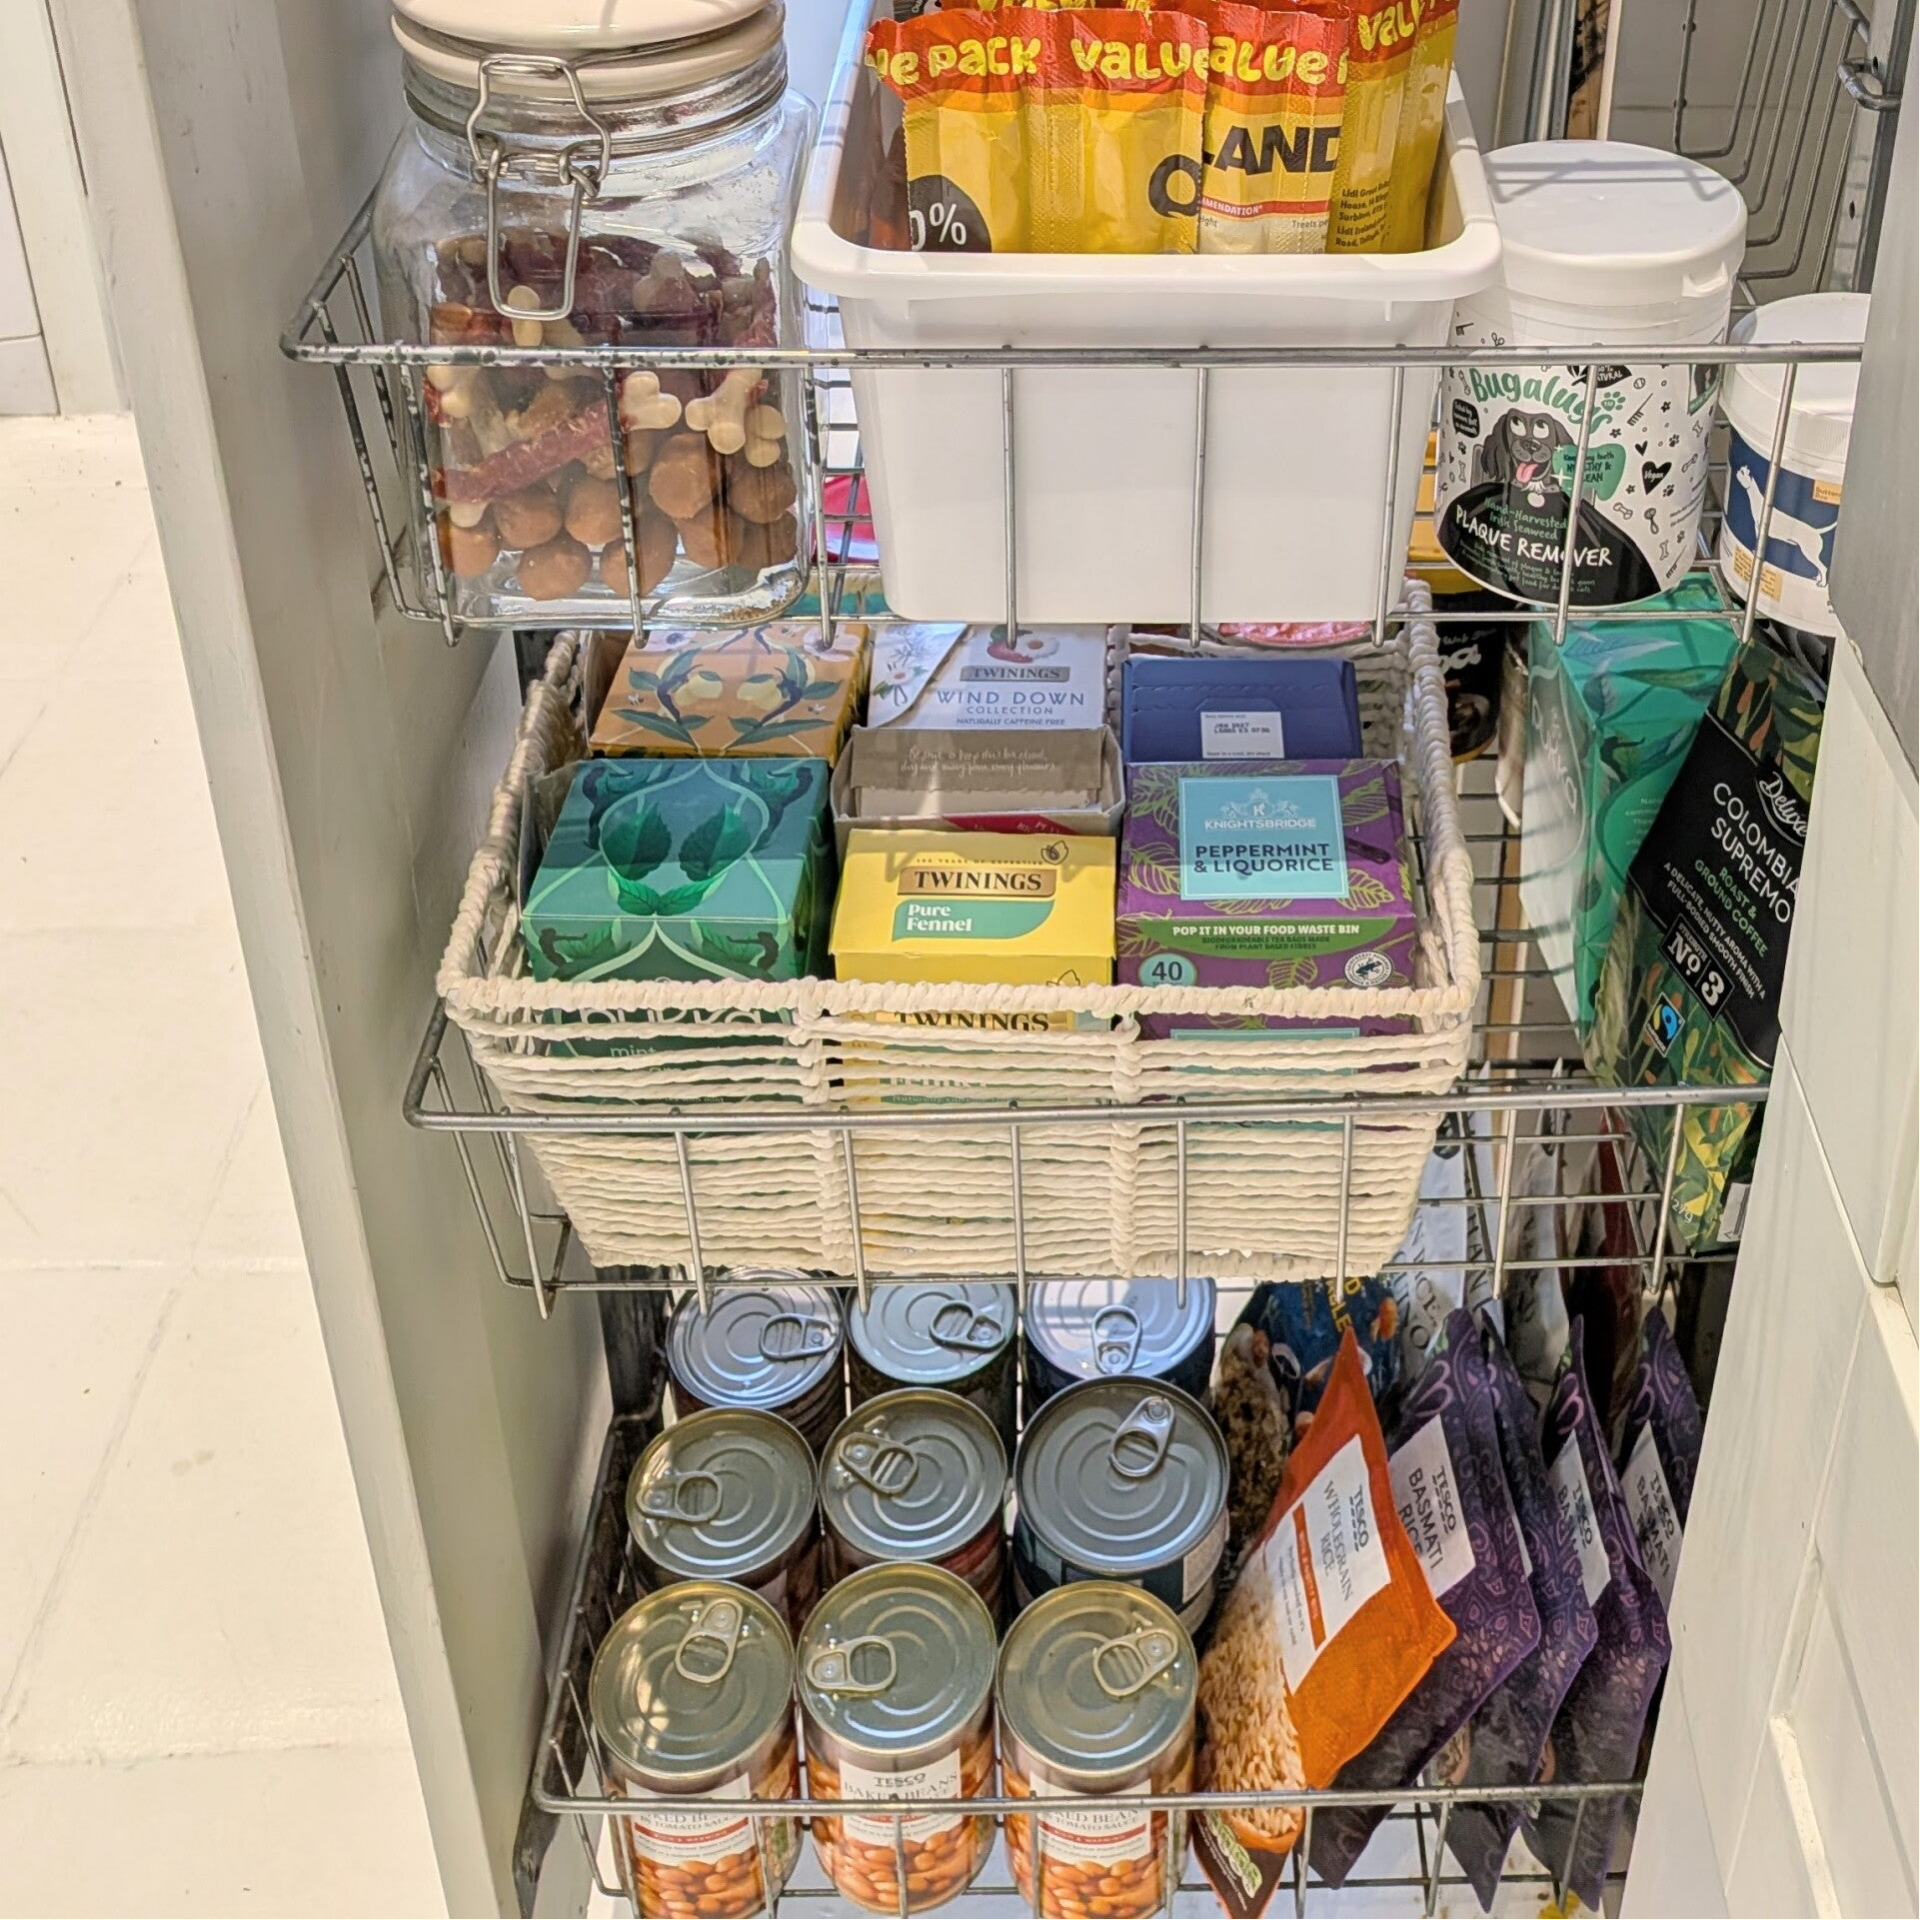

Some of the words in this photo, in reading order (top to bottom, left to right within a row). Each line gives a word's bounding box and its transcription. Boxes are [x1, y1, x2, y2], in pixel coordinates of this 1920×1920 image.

[1201, 196, 1263, 216] MENDATION
[908, 202, 967, 252] 0%
[1584, 472, 1604, 483] LEAN
[1644, 469, 1664, 483] Vegan
[1455, 504, 1513, 552] PLAQUE
[1513, 518, 1559, 541] Seaweed
[973, 667, 1061, 680] TWININGS
[937, 690, 1000, 705] WIND
[1012, 691, 1085, 706] DOWN
[966, 706, 1053, 715] COLLECTION
[956, 718, 1003, 726] NATURALLY
[1003, 718, 1043, 726] CAFFEINE
[1045, 718, 1066, 726] FREE
[1204, 818, 1316, 830] KNIGHTSBRIDGE
[1195, 843, 1330, 858] PEPPERMINT
[1193, 860, 1208, 873] &
[1214, 858, 1334, 876] LIQUORICE
[1711, 817, 1791, 923] SUPREMO
[914, 870, 1042, 891] TWININGS
[1719, 866, 1750, 908] ROAST
[1748, 905, 1758, 920] &
[907, 903, 951, 917] Pure
[1694, 859, 1733, 911] GROUND
[1731, 909, 1768, 958] COFFEE
[906, 917, 973, 932] Fennel
[1172, 926, 1198, 936] POP
[1199, 926, 1212, 935] IT
[1213, 926, 1227, 935] IN
[1228, 926, 1262, 935] YOUR
[1263, 925, 1296, 935] FOOD
[1297, 924, 1337, 935] WASTE
[1338, 924, 1360, 934] BIN
[1663, 862, 1671, 872] A
[1670, 867, 1705, 912] DELICATE,
[1703, 907, 1727, 937] NUTTY
[1724, 933, 1748, 970] AROMA
[1746, 963, 1763, 991] WITH
[1759, 989, 1766, 1000] A
[1667, 880, 1709, 934] FULL-BODIED
[1708, 930, 1737, 970] SMOOTH
[1735, 967, 1755, 999] FINISH
[1151, 961, 1184, 981] 40
[1700, 970, 1725, 1007] 3
[893, 1010, 1050, 1032] TWININGS
[1435, 1465, 1457, 1532] TESCO
[1354, 1483, 1370, 1548] TESCO
[1408, 1467, 1444, 1570] BASMATI
[1323, 1479, 1354, 1602] WHOLEGRAIN
[1320, 1531, 1336, 1578] RICE
[873, 1772, 926, 1786] TESCO
[844, 1781, 898, 1801] BAKE
[1092, 1808, 1140, 1824] BEAN
